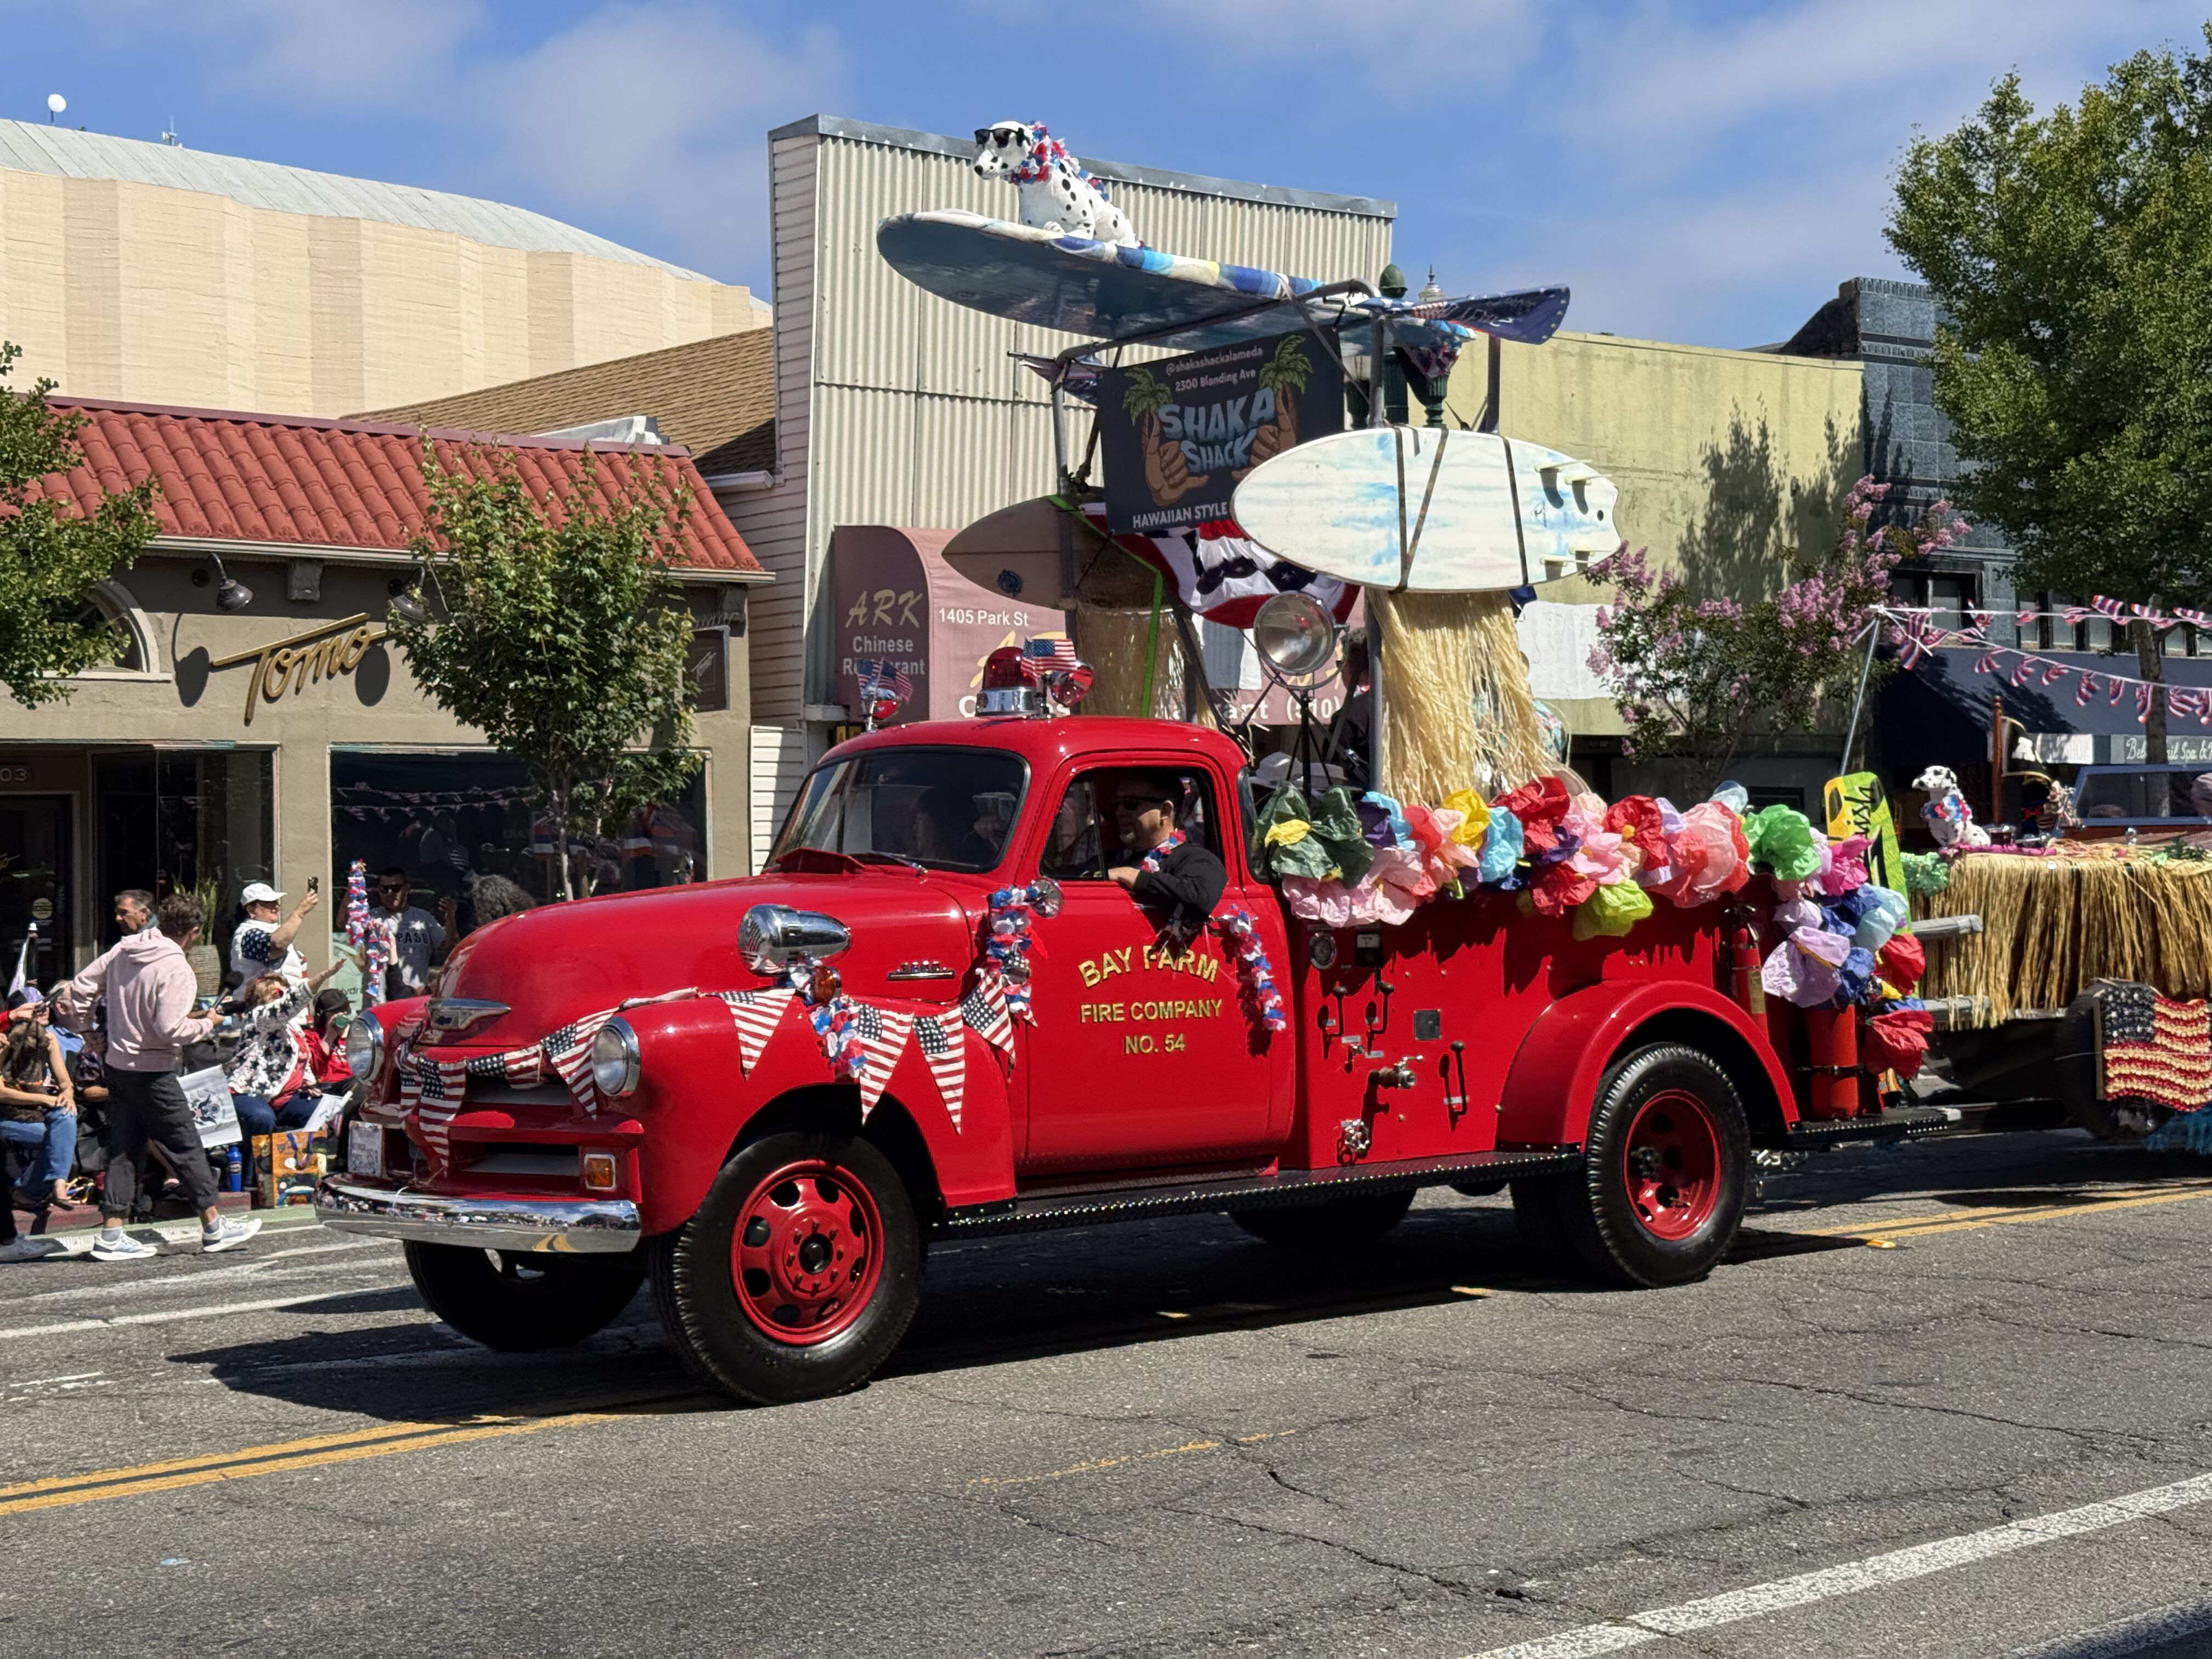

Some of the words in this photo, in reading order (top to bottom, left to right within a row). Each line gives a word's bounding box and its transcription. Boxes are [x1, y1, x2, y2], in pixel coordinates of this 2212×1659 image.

[1166, 346, 1263, 375] @shakashackalameda
[1175, 376, 1198, 391] 2300
[1200, 370, 1238, 387] Blanding
[1239, 369, 1256, 381] Ave
[1158, 386, 1276, 443] SHAKA
[1180, 429, 1258, 474] SHACK
[1132, 509, 1192, 528] HAWAIIAN
[1194, 501, 1228, 520] STYLE
[845, 589, 924, 629] ARK
[939, 608, 974, 624] 1405
[978, 610, 1010, 626] Park
[1013, 612, 1029, 627] St
[853, 635, 914, 653] Chinese
[2180, 741, 2198, 763] Spa
[1077, 946, 1133, 989] BAY
[1143, 945, 1220, 983] FARM
[1080, 1003, 1125, 1024] FIRE
[1130, 999, 1223, 1022] COMPANY
[1124, 1034, 1159, 1056] NO.
[1164, 1033, 1186, 1054] 54
